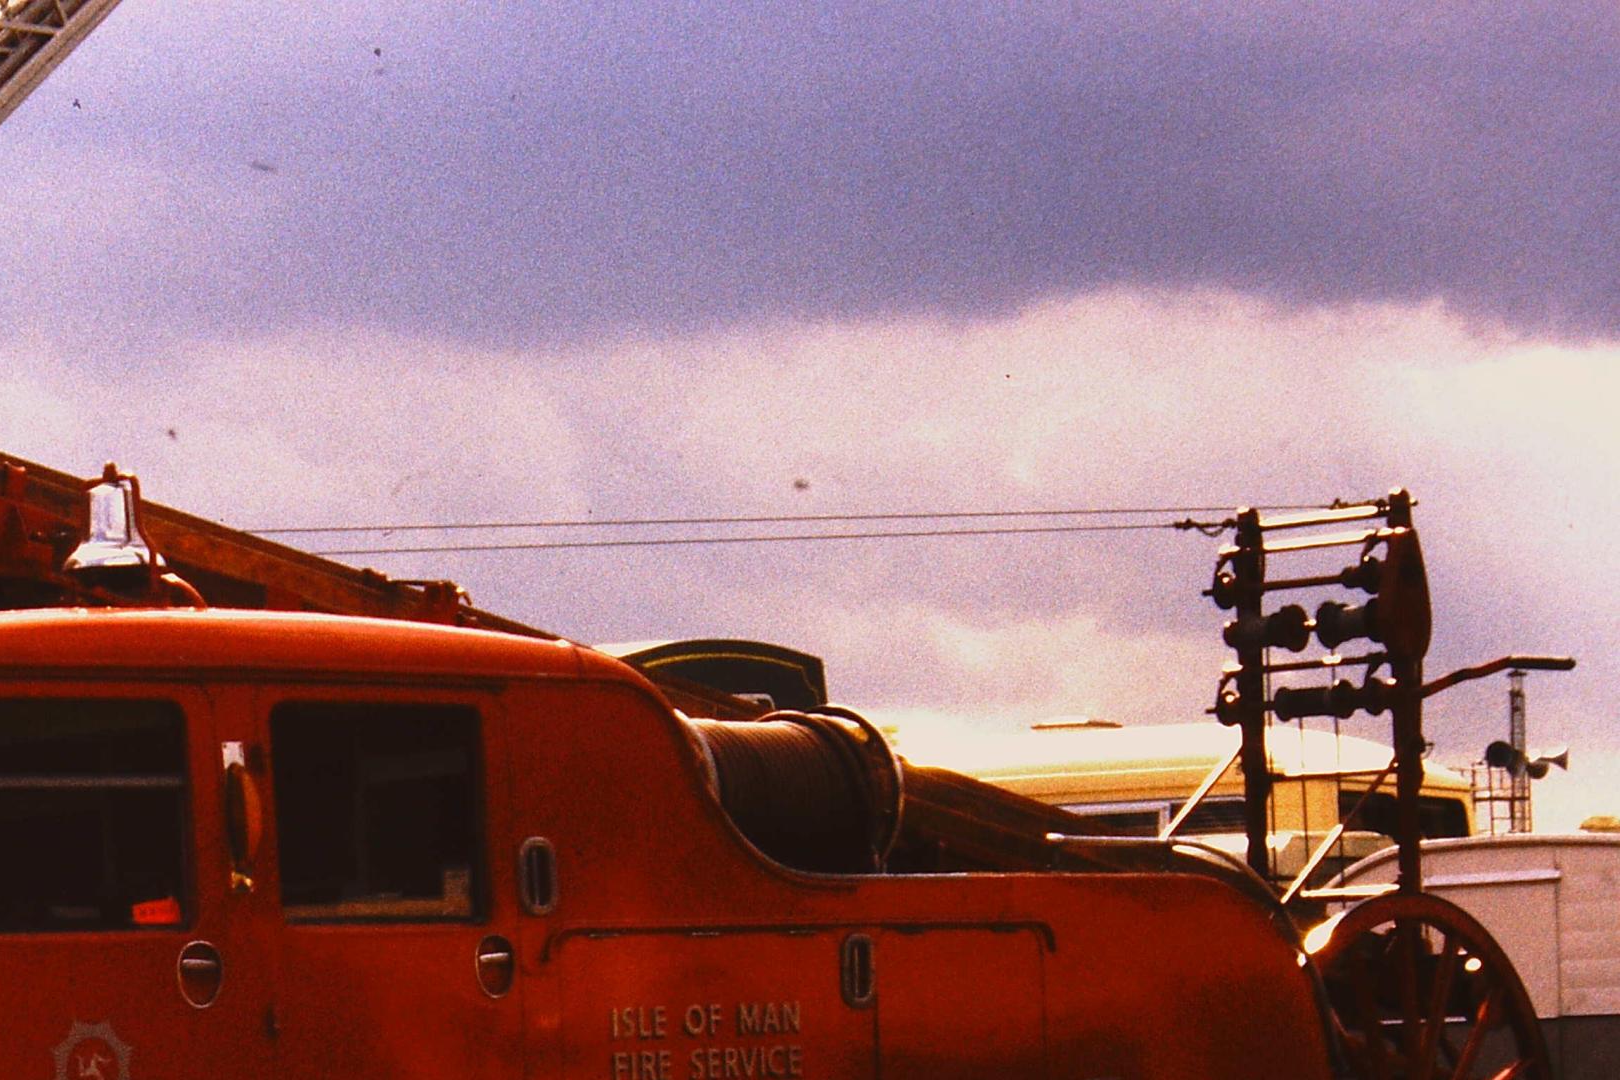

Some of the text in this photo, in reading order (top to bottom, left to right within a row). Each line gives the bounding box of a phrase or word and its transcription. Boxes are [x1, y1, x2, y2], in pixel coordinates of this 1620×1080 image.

[611, 1000, 802, 1039] ISLE OF MAN
